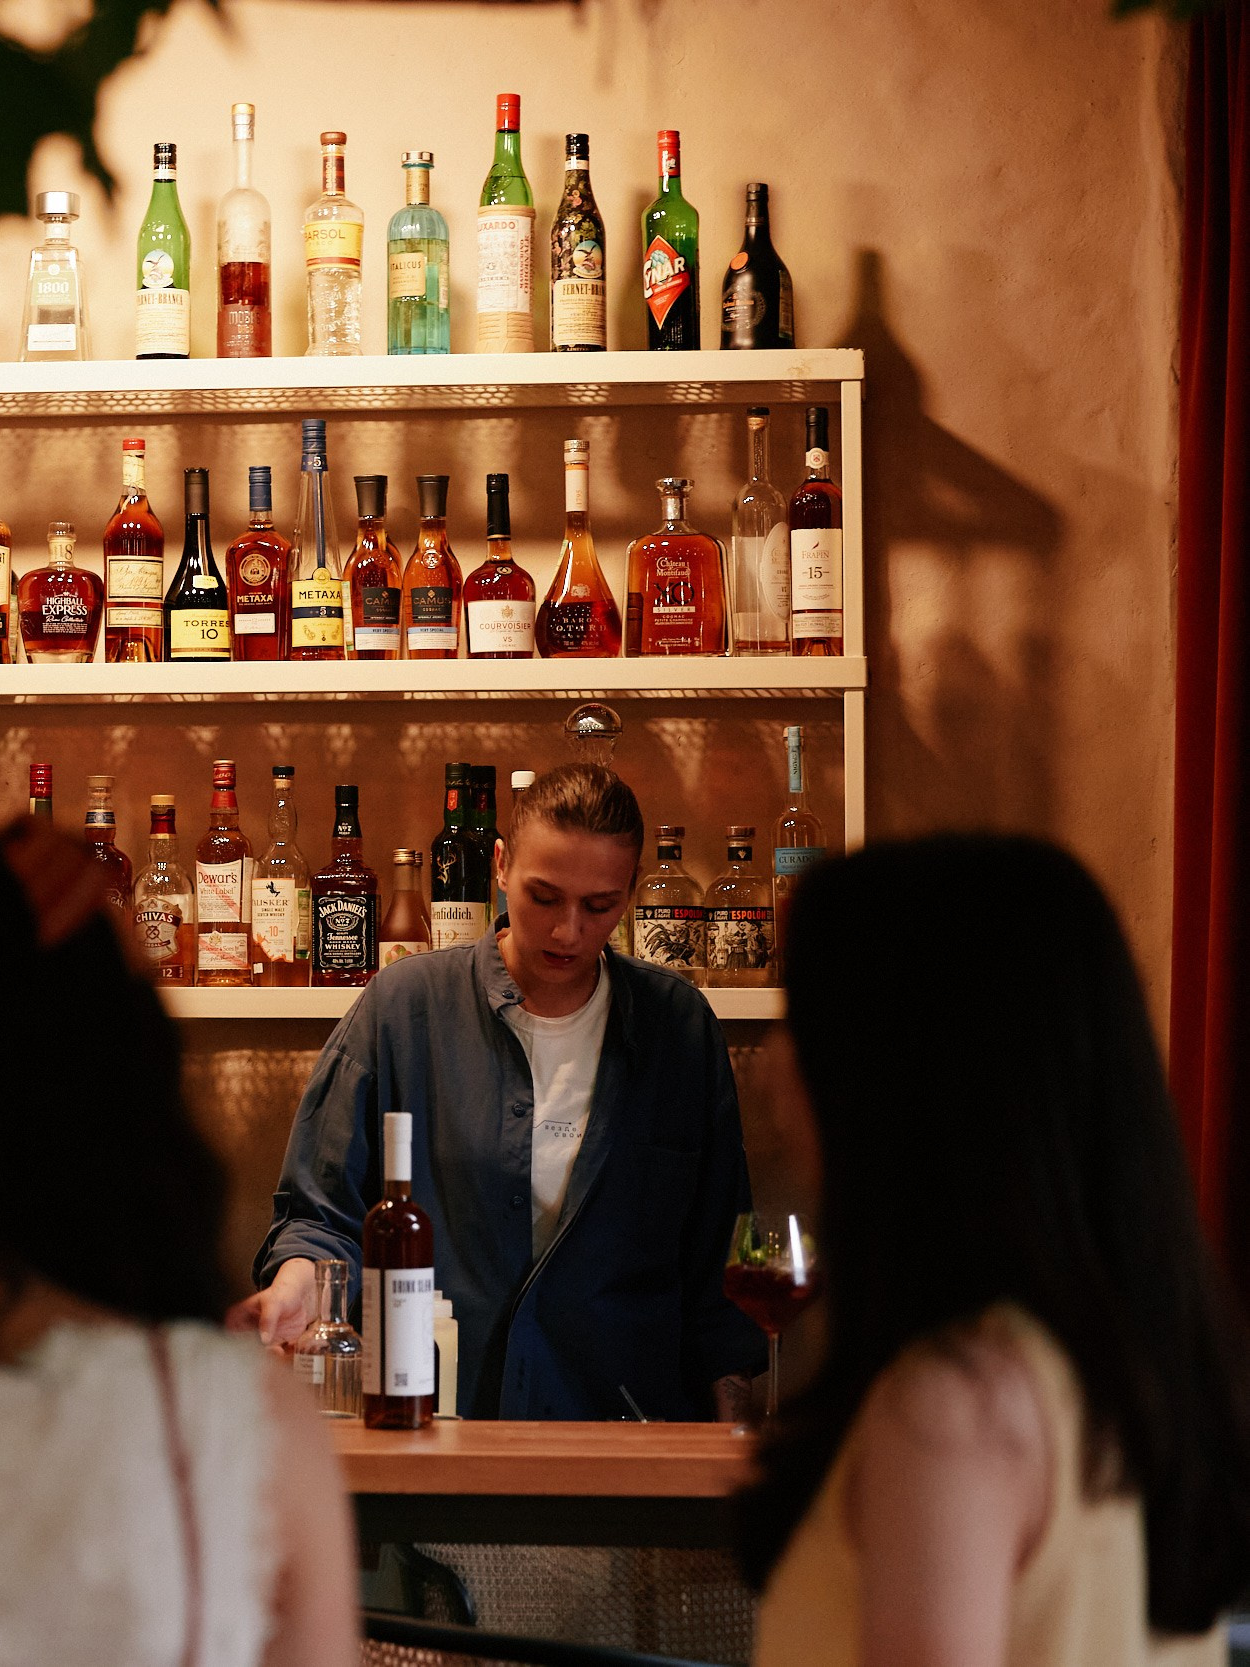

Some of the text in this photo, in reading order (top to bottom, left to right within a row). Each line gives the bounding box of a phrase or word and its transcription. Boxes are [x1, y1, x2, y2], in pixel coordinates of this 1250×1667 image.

[644, 256, 685, 299] CYNAR
[38, 282, 69, 294] 1800
[313, 457, 322, 467] 5
[237, 593, 273, 604] METAXA
[299, 590, 341, 601] METAXA
[654, 581, 694, 606] XO
[46, 597, 84, 606] HIGHBALL
[414, 597, 452, 606] CAMUS
[42, 605, 88, 616] EXPRESS
[184, 620, 230, 628] TORRES
[480, 621, 531, 631] COURVOISIER
[201, 629, 220, 640] 10
[319, 900, 367, 918] JACK DANIEL'S
[136, 911, 174, 923] CHIVAS
[269, 926, 279, 937] 10
[327, 933, 359, 941] Tennessee
[162, 969, 173, 979] 12
